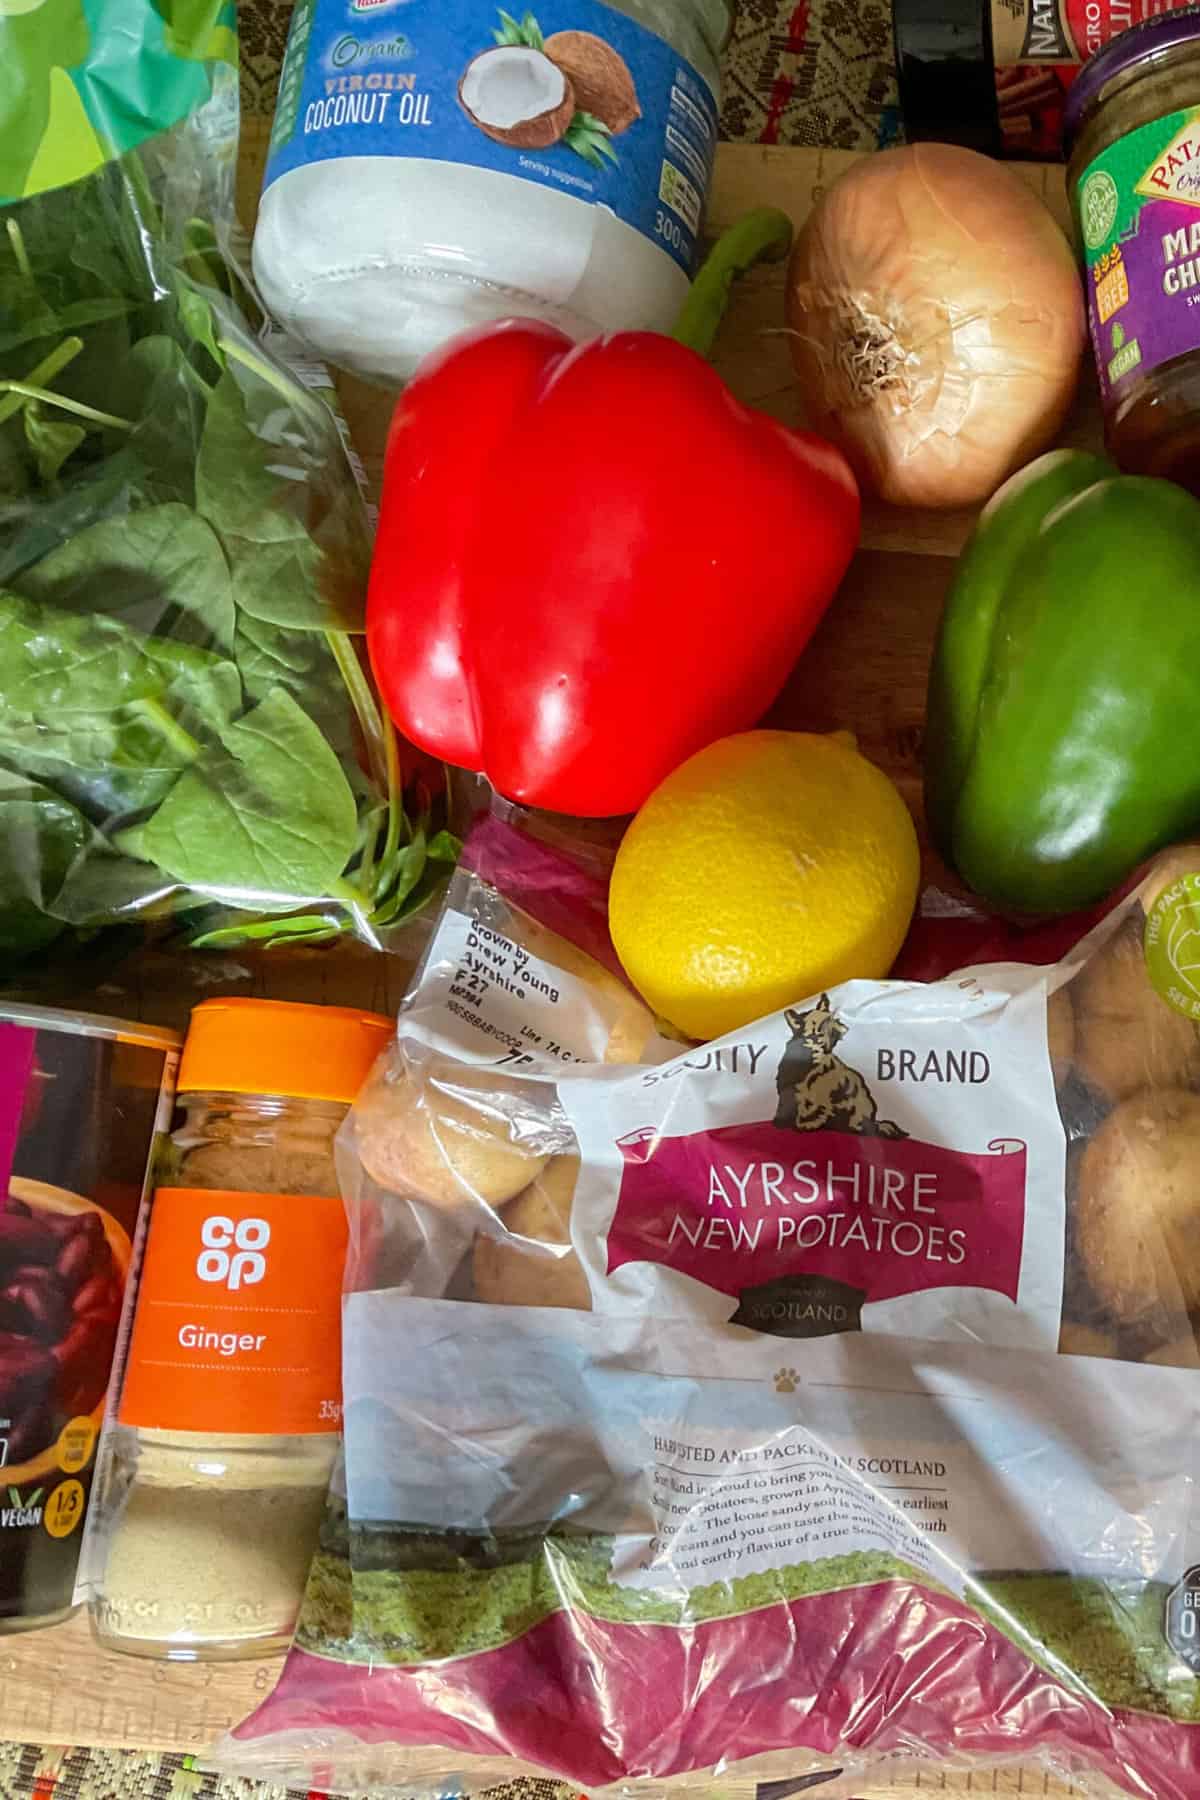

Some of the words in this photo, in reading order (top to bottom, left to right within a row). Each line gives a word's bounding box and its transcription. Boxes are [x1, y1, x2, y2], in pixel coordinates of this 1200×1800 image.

[332, 35, 408, 67] Organic
[325, 74, 416, 95] VIRGIN
[304, 93, 391, 133] COCONUT
[400, 93, 432, 124] OIL
[515, 944, 530, 965] by
[466, 932, 508, 968] Drew
[512, 959, 560, 1004] Young
[467, 974, 490, 993] 27
[520, 1025, 542, 1043] Line
[876, 1048, 991, 1084] BRAND
[707, 1159, 938, 1214] AYRSHIRE
[667, 1216, 761, 1252] NEW
[777, 1213, 967, 1265] POTATOES
[752, 1302, 848, 1321] SCOTLAND
[178, 1323, 266, 1355] Ginger
[754, 1479, 767, 1488] to
[770, 1471, 807, 1487] bring
[809, 1470, 832, 1481] you
[857, 1458, 947, 1477] SCOTLAND
[761, 1491, 803, 1505] grown
[806, 1484, 819, 1494] in
[903, 1496, 949, 1511] earliest
[1, 1507, 42, 1527] VEGAN
[704, 1515, 732, 1530] The
[734, 1512, 768, 1522] loose
[771, 1502, 811, 1517] sandy
[814, 1497, 837, 1508] soil
[712, 1530, 737, 1546] and
[740, 1525, 765, 1541] you
[768, 1523, 792, 1532] can
[794, 1514, 825, 1528] taste
[702, 1548, 743, 1565] earthy
[795, 1533, 809, 1545] of
[823, 1527, 849, 1539] true
